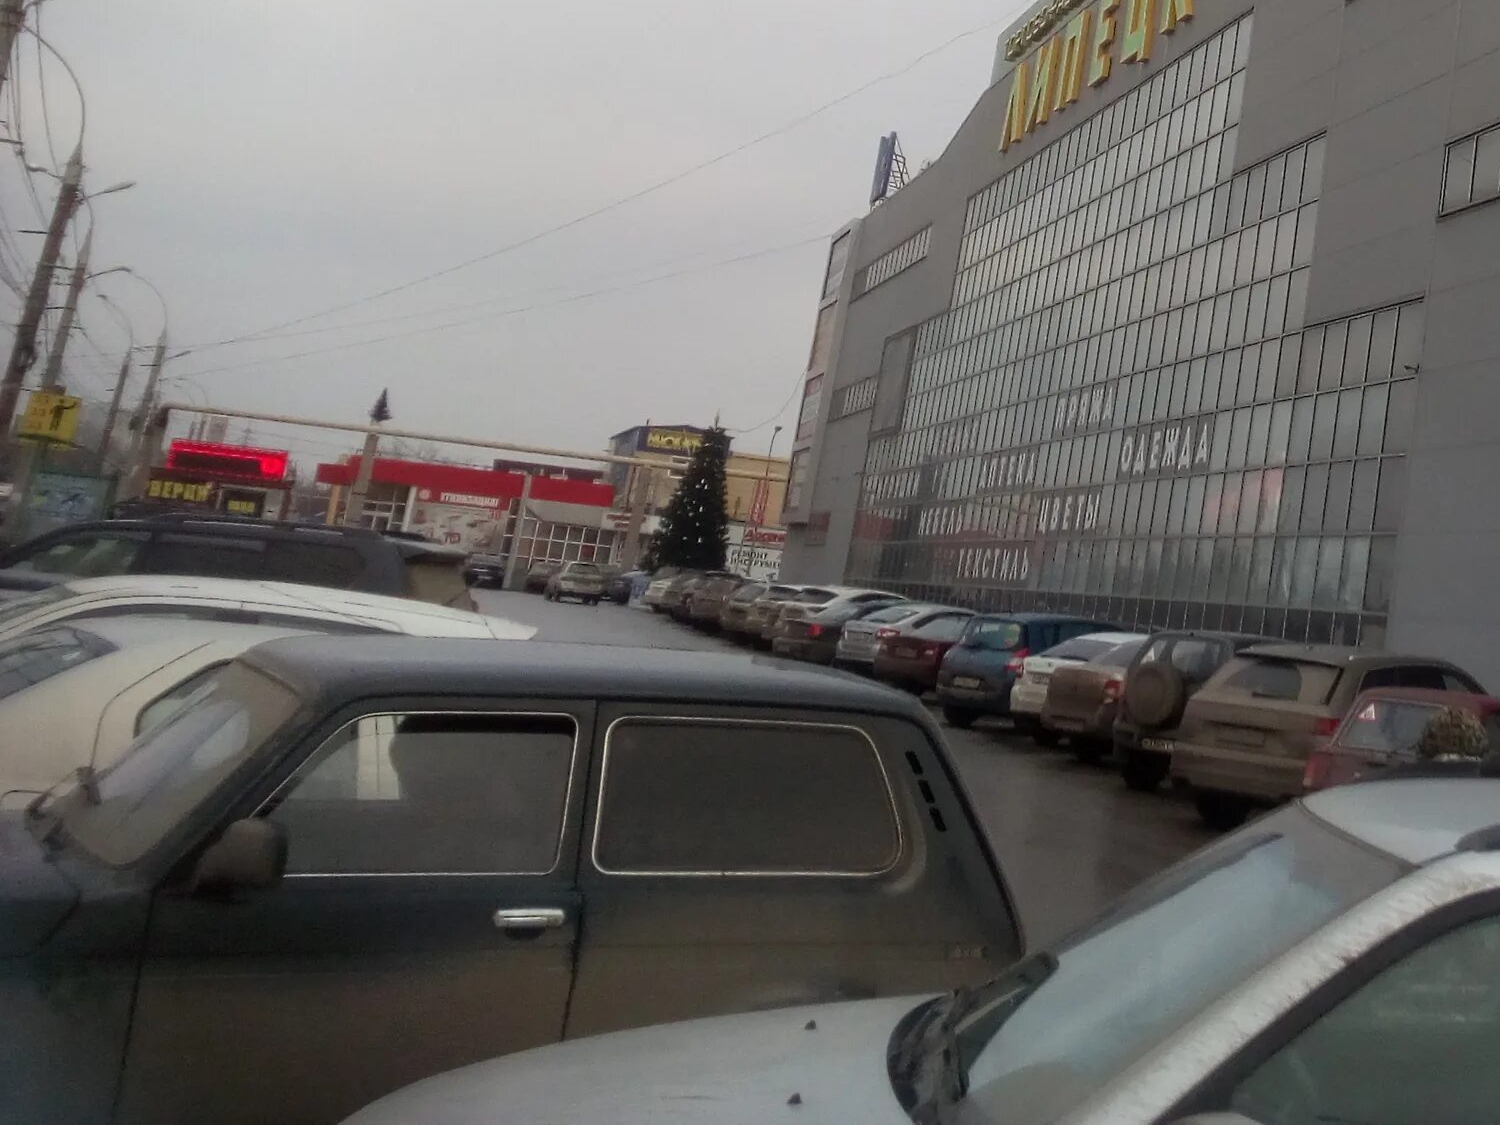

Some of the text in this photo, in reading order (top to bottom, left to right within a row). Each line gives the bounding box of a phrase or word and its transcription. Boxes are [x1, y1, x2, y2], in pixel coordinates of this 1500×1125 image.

[1054, 386, 1115, 431] ПРЯЖА
[1120, 424, 1210, 475] ОДЕЖДА
[978, 452, 1037, 490] АПТЕКА
[1039, 493, 1100, 535] ЦВЕТЫ
[955, 547, 1030, 582] ТЕКСТИЛЬ
